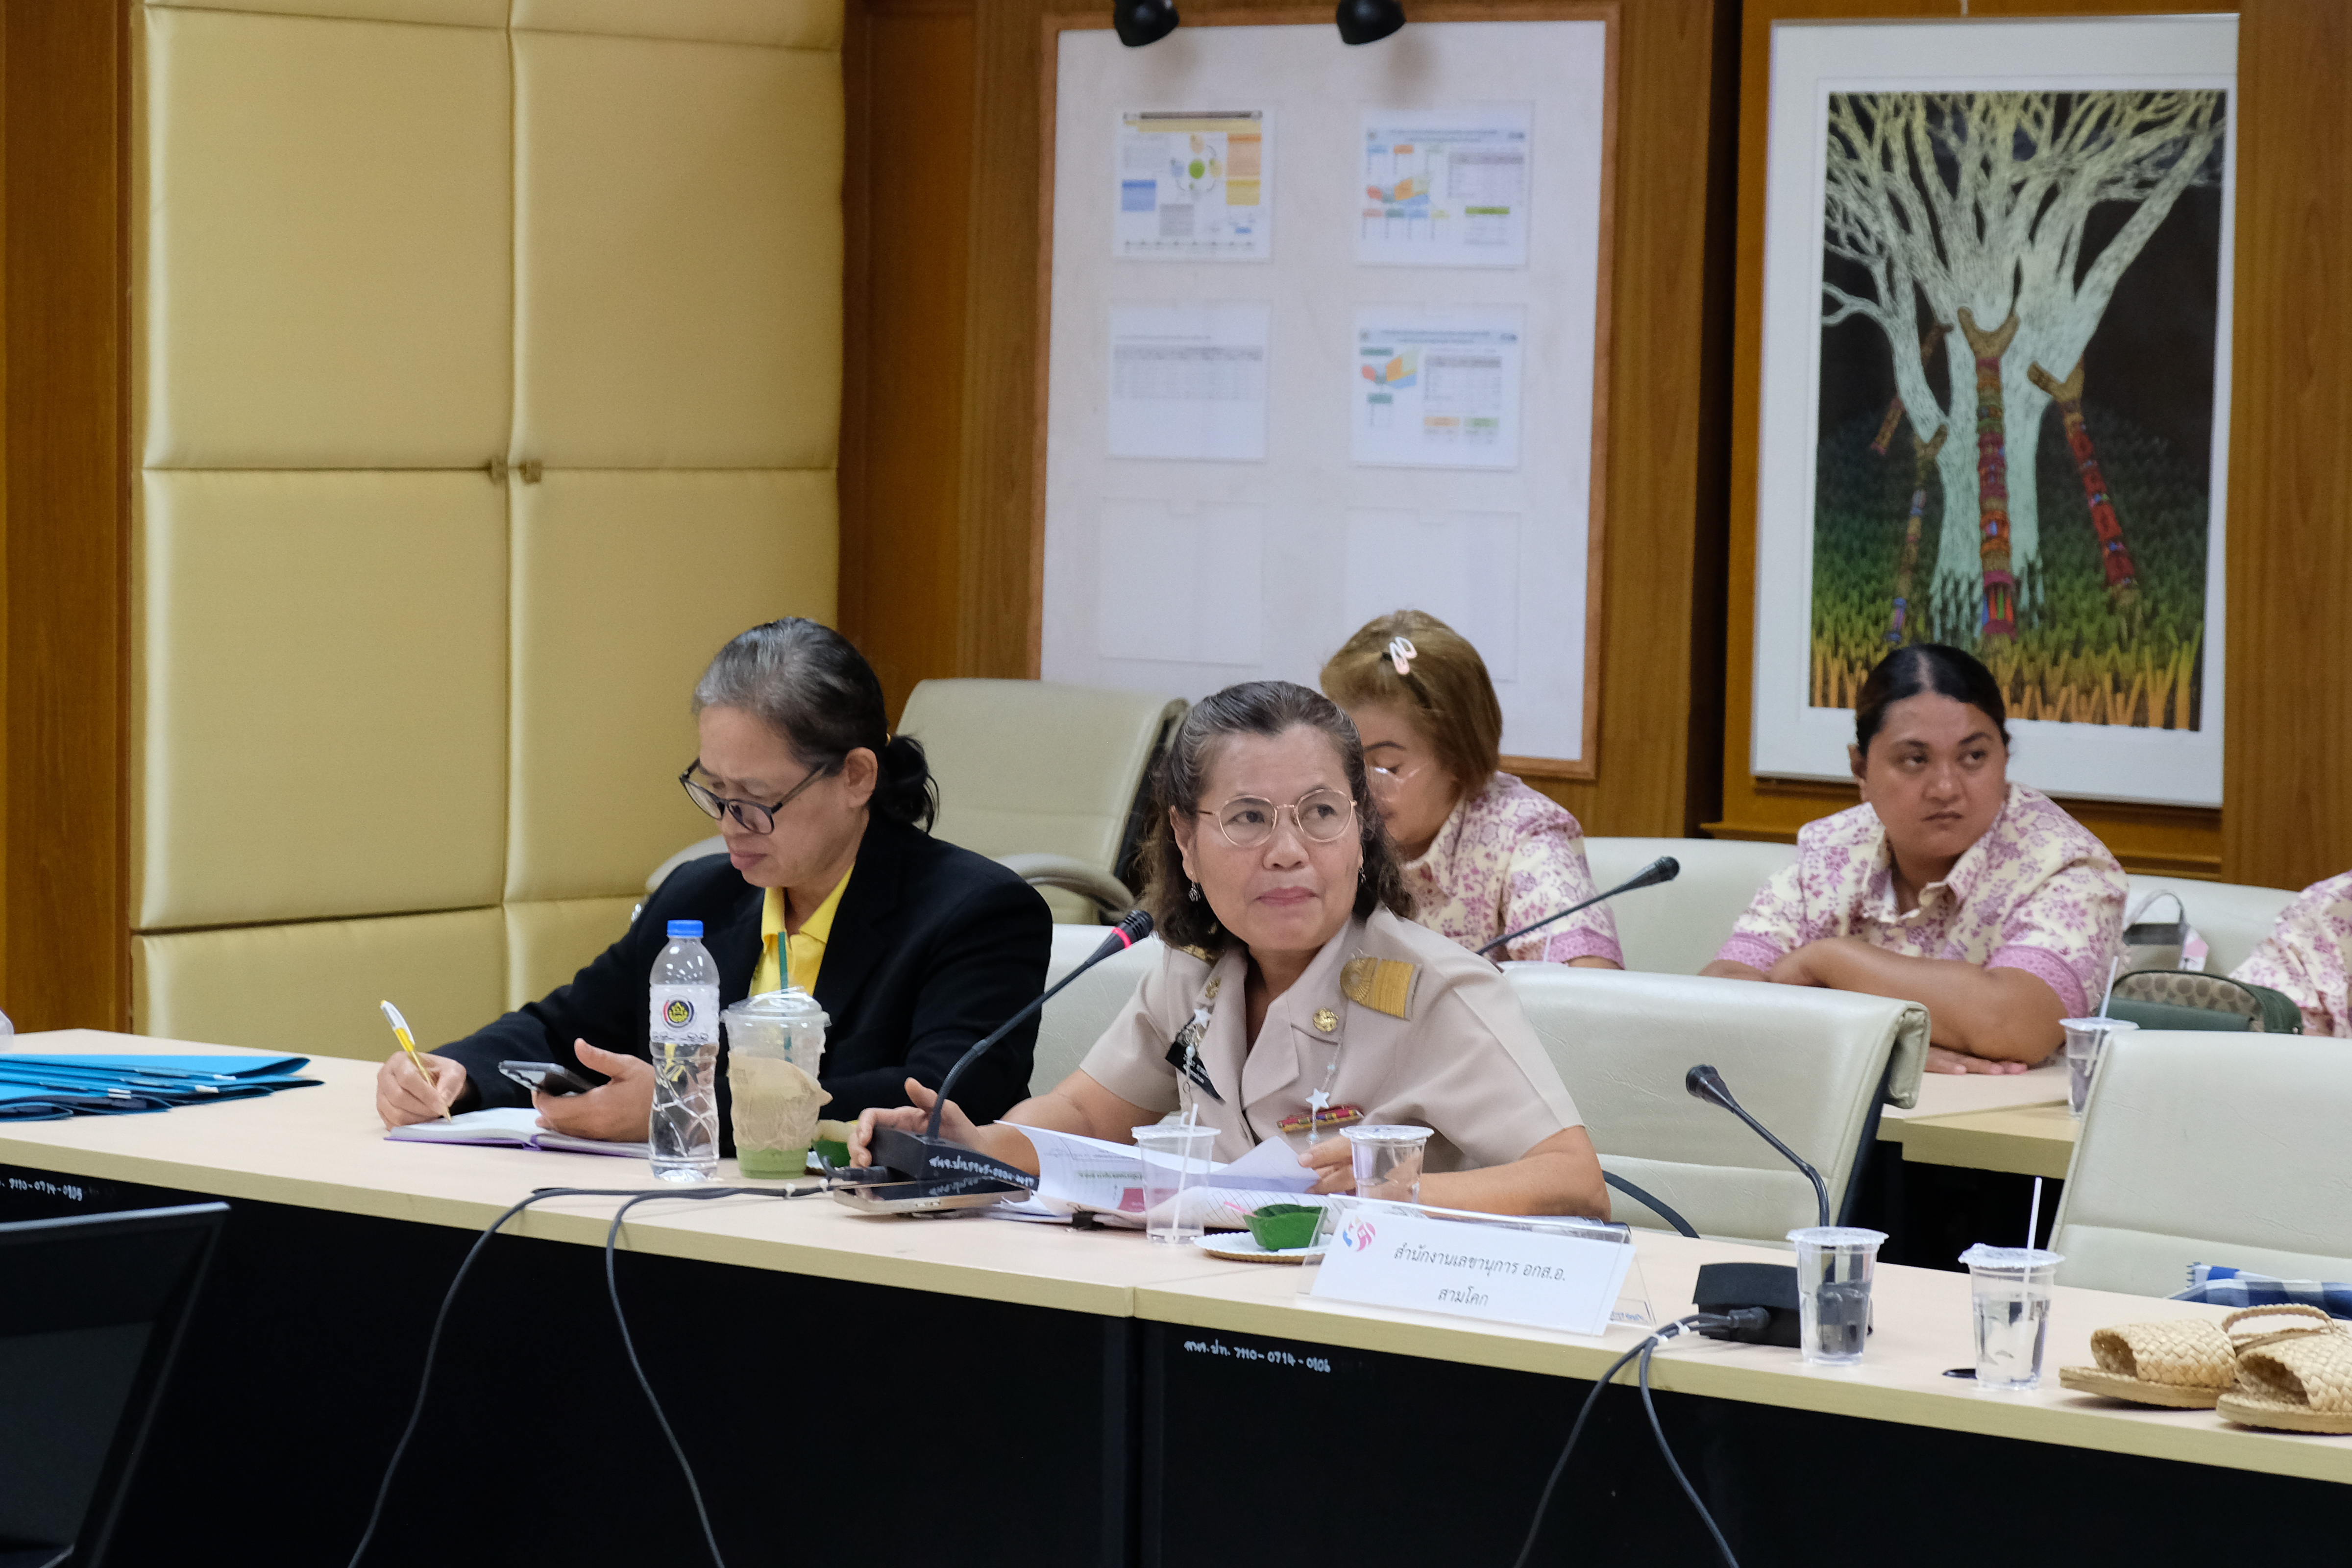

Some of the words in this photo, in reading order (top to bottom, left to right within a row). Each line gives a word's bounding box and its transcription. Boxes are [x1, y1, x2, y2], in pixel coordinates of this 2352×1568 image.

[1394, 1242, 1519, 1277] สำนักงานเลขานุการ
[1522, 1263, 1566, 1281] อกส.อ.
[1438, 1286, 1489, 1307] สามโคก
